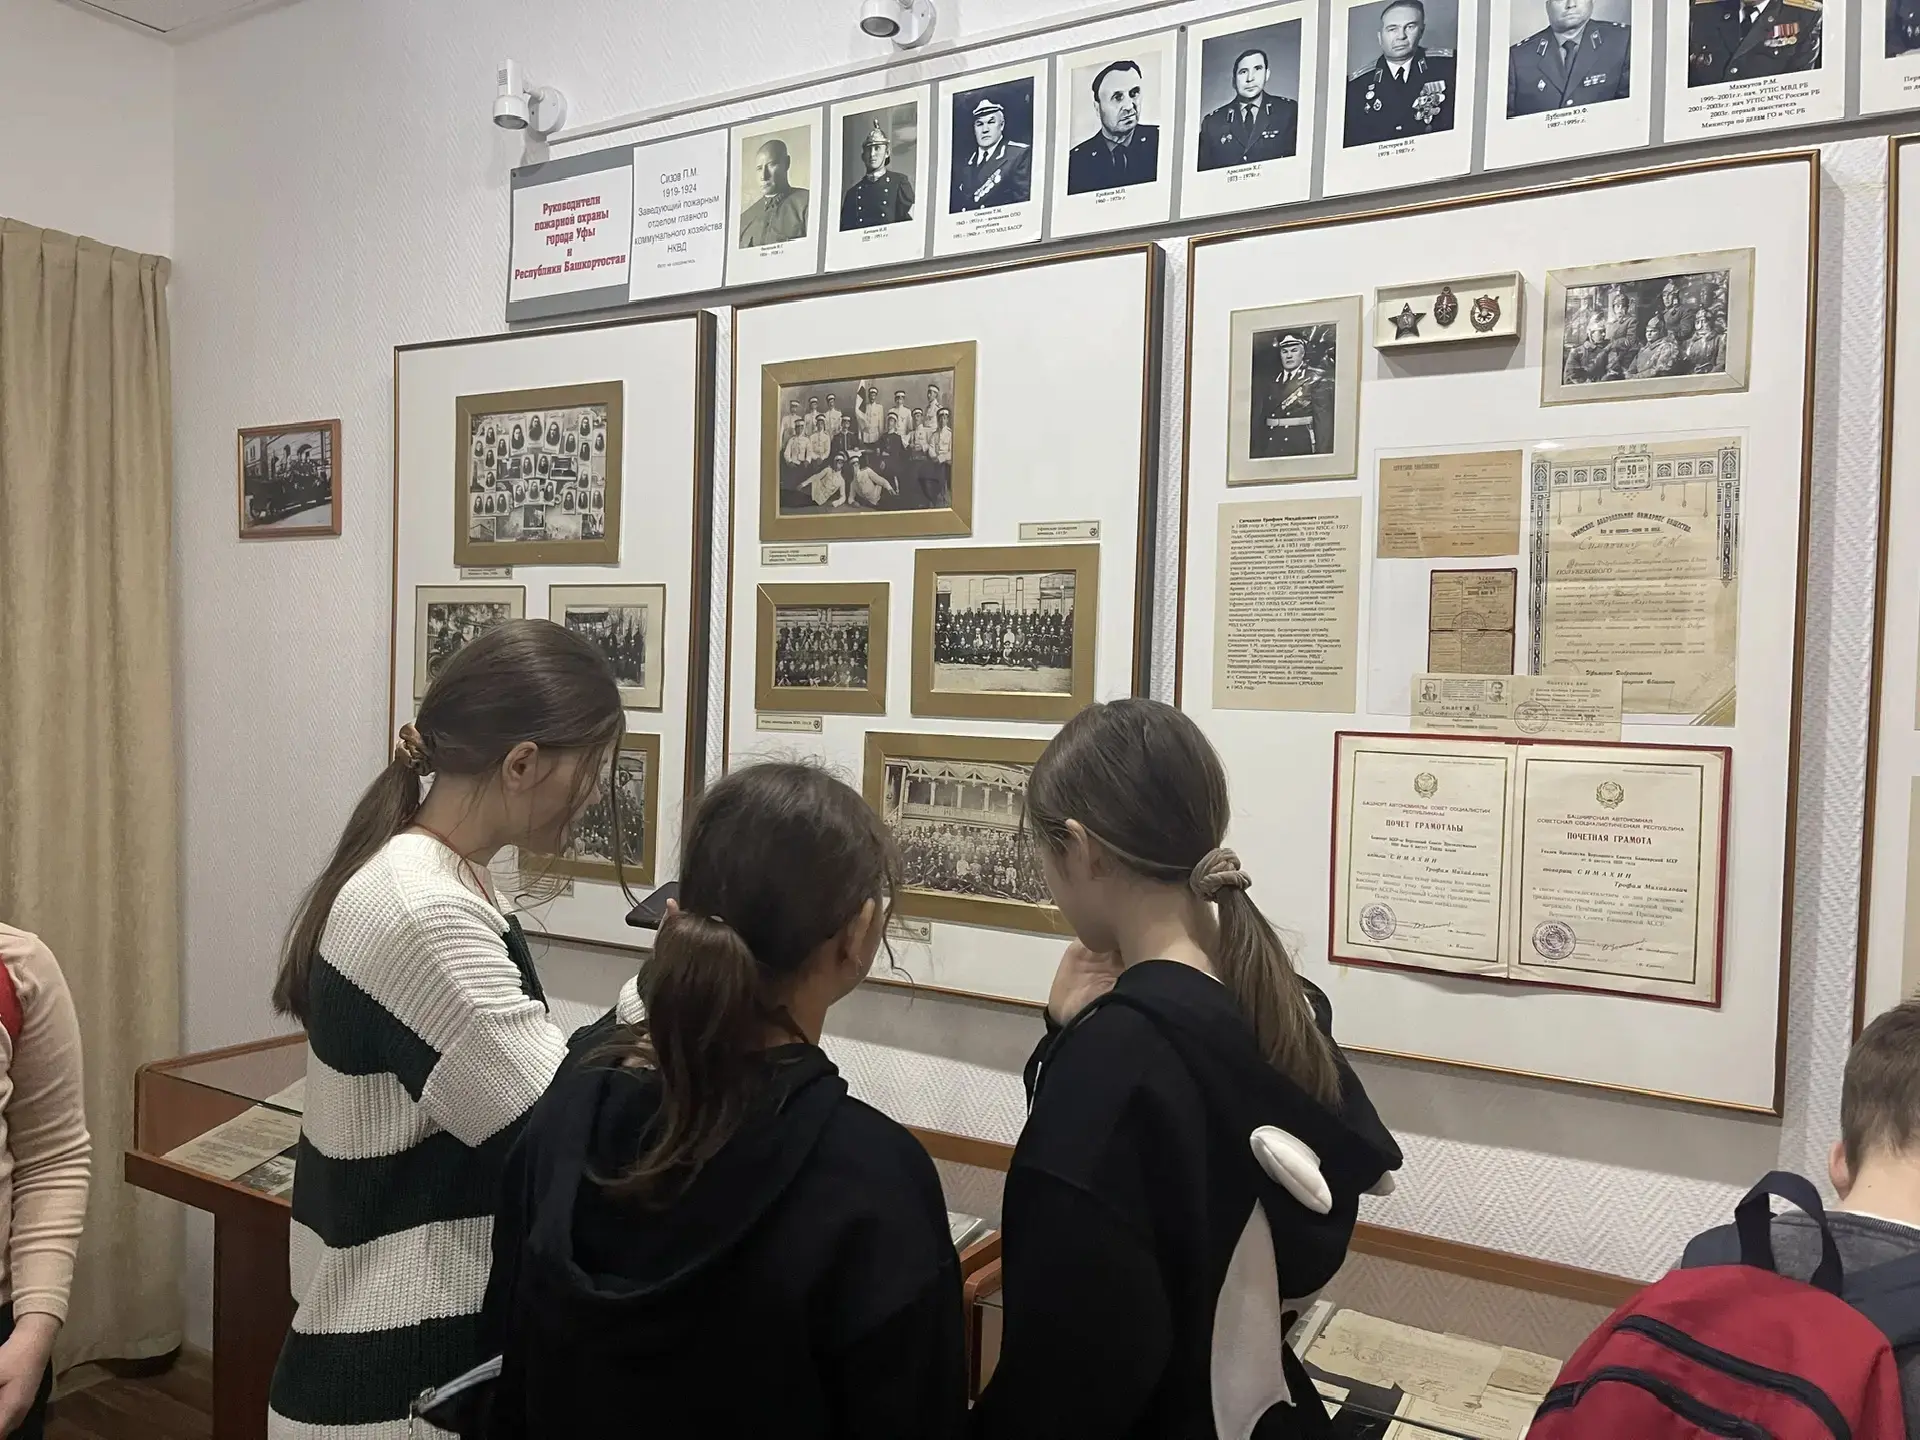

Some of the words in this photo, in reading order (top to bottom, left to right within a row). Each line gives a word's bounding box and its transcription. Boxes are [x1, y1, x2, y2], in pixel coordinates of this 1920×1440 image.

[1766, 94, 1784, 102] МЧС
[1732, 106, 1756, 115] первый
[1758, 102, 1796, 111] заместитель
[1702, 120, 1734, 128] Министра
[660, 172, 681, 184] Сизов
[682, 168, 698, 179] П.М.
[662, 184, 697, 198] 1919-1924
[542, 196, 600, 216] Руководители
[638, 200, 682, 216] Заведующий
[683, 196, 720, 208] пожарным
[534, 214, 574, 231] пожарной
[577, 210, 609, 224] охраны
[648, 217, 676, 228] отделом
[678, 212, 708, 223] главного
[546, 232, 574, 246] города
[576, 226, 596, 242] Уфы
[634, 229, 686, 246] коммунального
[688, 222, 722, 235] хозяйства
[567, 248, 572, 256] и
[667, 242, 687, 252] НКВД
[514, 265, 562, 280] Республики
[564, 254, 626, 272] Башкортостан
[1626, 464, 1636, 475] 50
[1386, 820, 1410, 828] ПОЧЕТ
[1575, 820, 1640, 829] СОЦИАЛИСТИЧЕСКАЯ
[1612, 816, 1653, 824] АВТОНОМНАЯ
[1567, 832, 1608, 842] ПОЧЕТНАЯ
[1614, 835, 1652, 845] ГРАМОТА
[1614, 882, 1642, 890] Трофим
[1645, 884, 1688, 893] Михайлович
